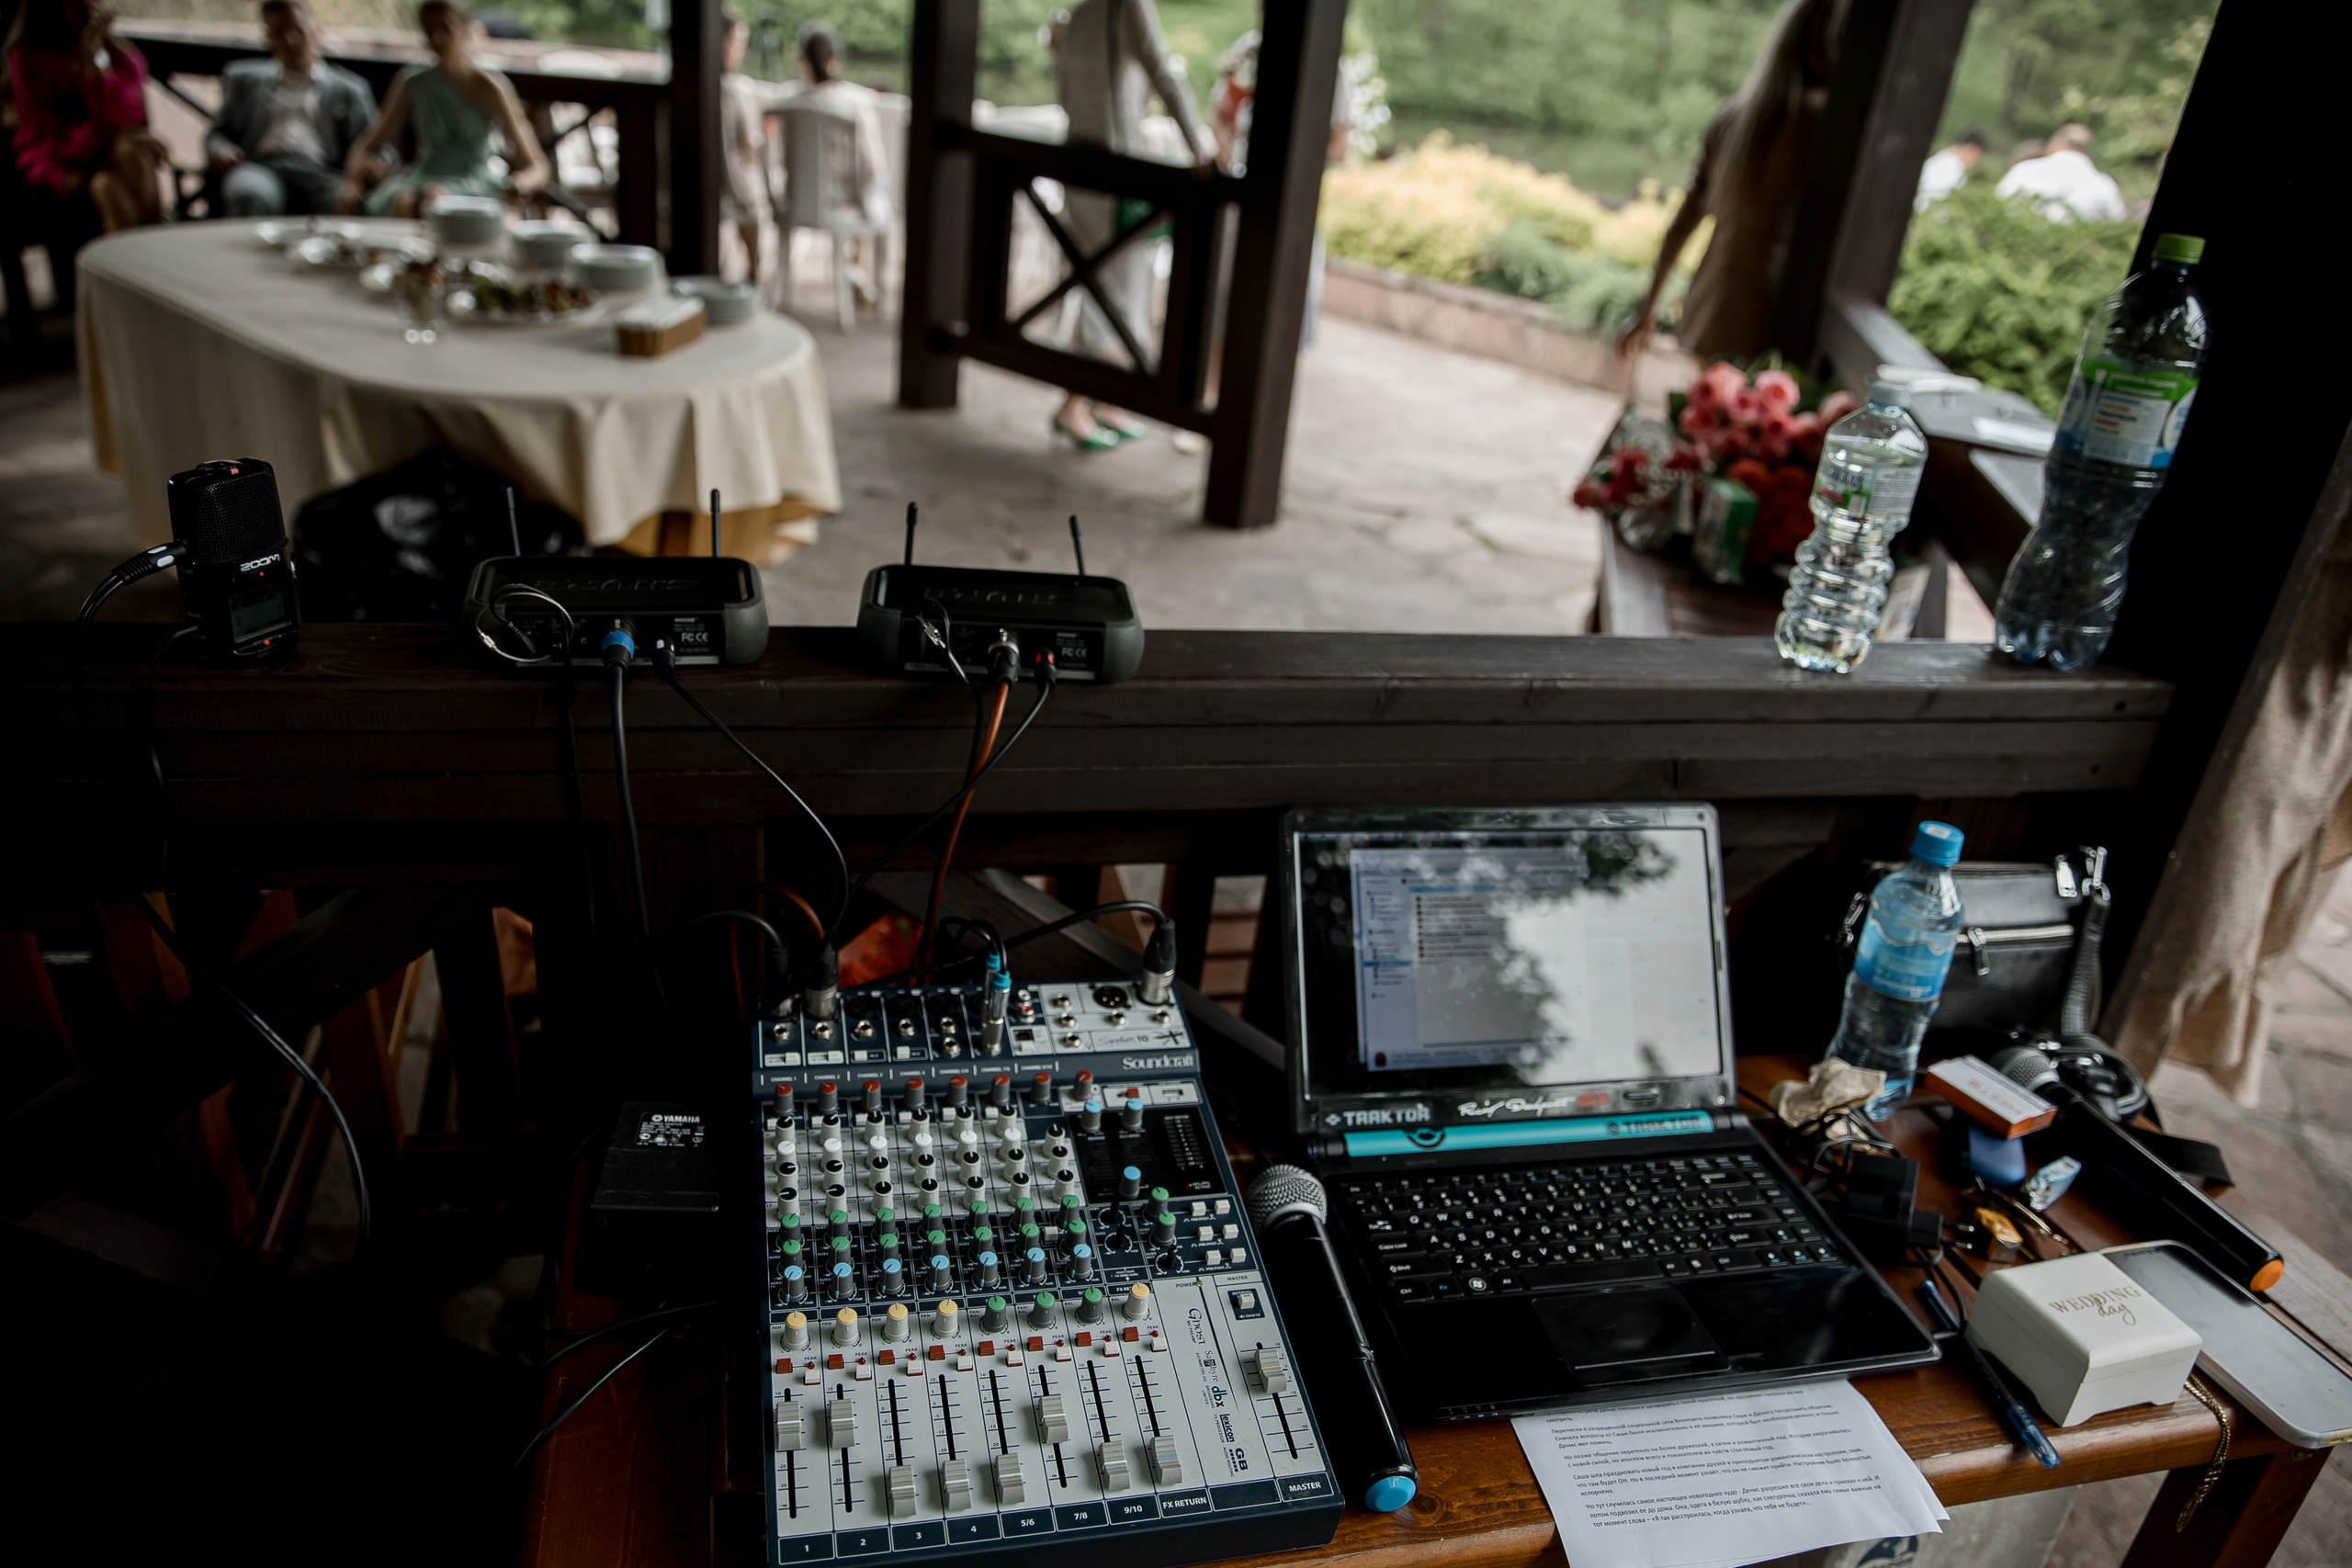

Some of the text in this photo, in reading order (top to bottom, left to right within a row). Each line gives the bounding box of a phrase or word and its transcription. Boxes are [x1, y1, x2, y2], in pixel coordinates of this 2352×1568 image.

[240, 553, 280, 572] ZOOM
[1122, 1053, 1193, 1071] Soundcraft
[663, 1114, 701, 1123] YAMAHA
[1343, 1105, 1430, 1126] TRAKTOR
[2049, 1285, 2142, 1314] WEDDING
[2094, 1296, 2136, 1326] day
[1212, 1386, 1227, 1407] dbx
[1235, 1448, 1249, 1471] GB
[1289, 1482, 1321, 1493] MASTER
[1124, 1505, 1143, 1514] 9/10
[1162, 1497, 1207, 1509] FX RETURN
[1021, 1518, 1035, 1527] 5/6
[1671, 1512, 1713, 1520] расстроилась,
